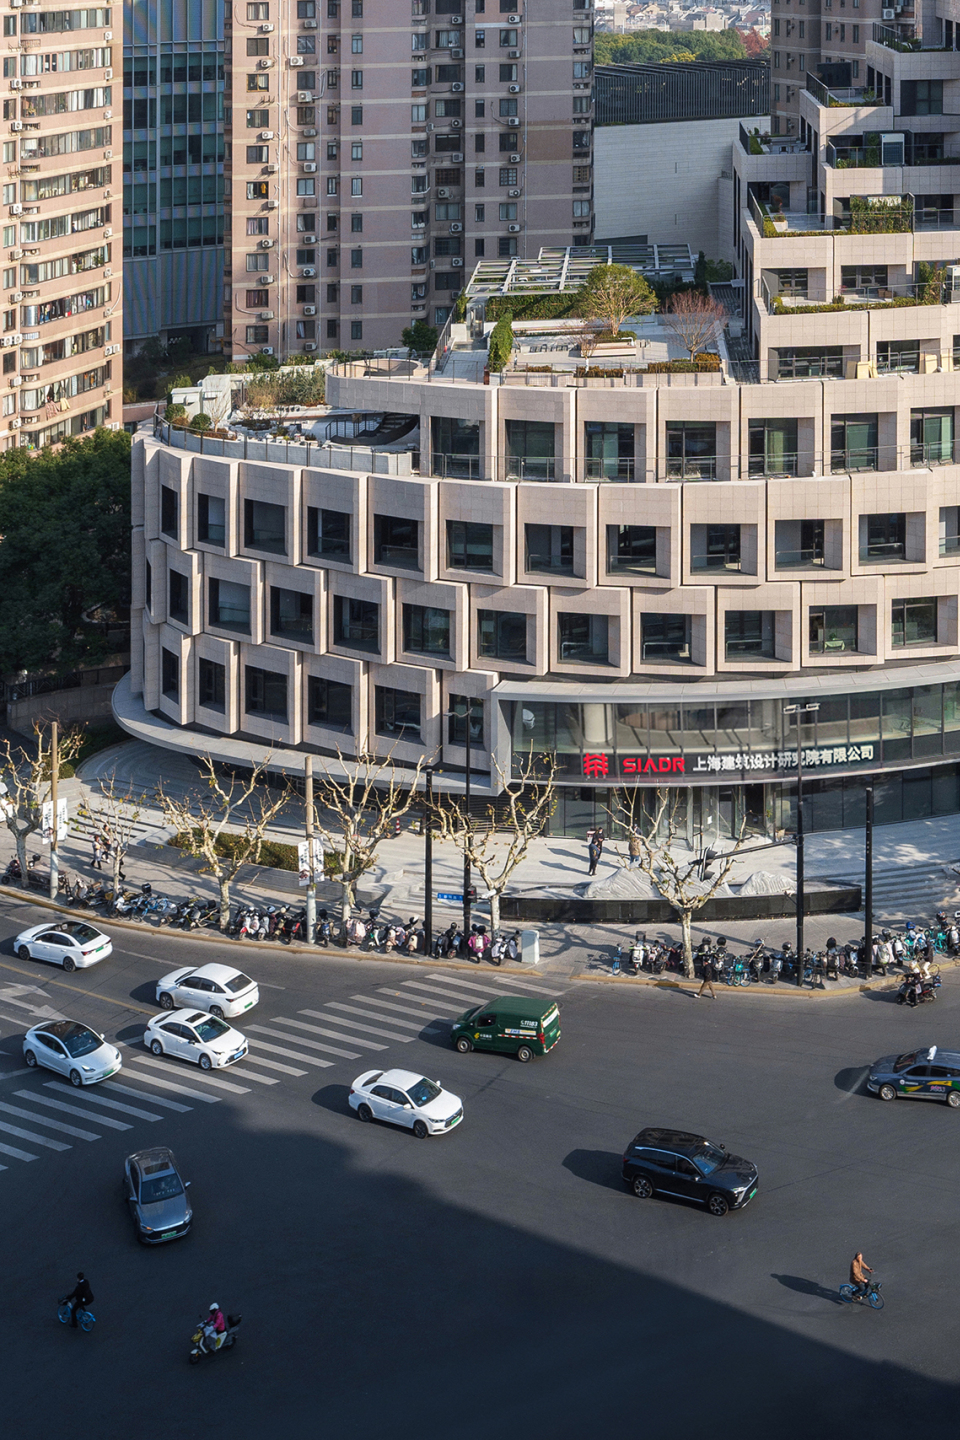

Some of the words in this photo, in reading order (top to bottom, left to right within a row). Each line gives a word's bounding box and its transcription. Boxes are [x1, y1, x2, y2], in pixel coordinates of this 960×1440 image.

[622, 757, 686, 773] SIADR
[692, 745, 874, 772] 上海建筑设计研究院有限公司
